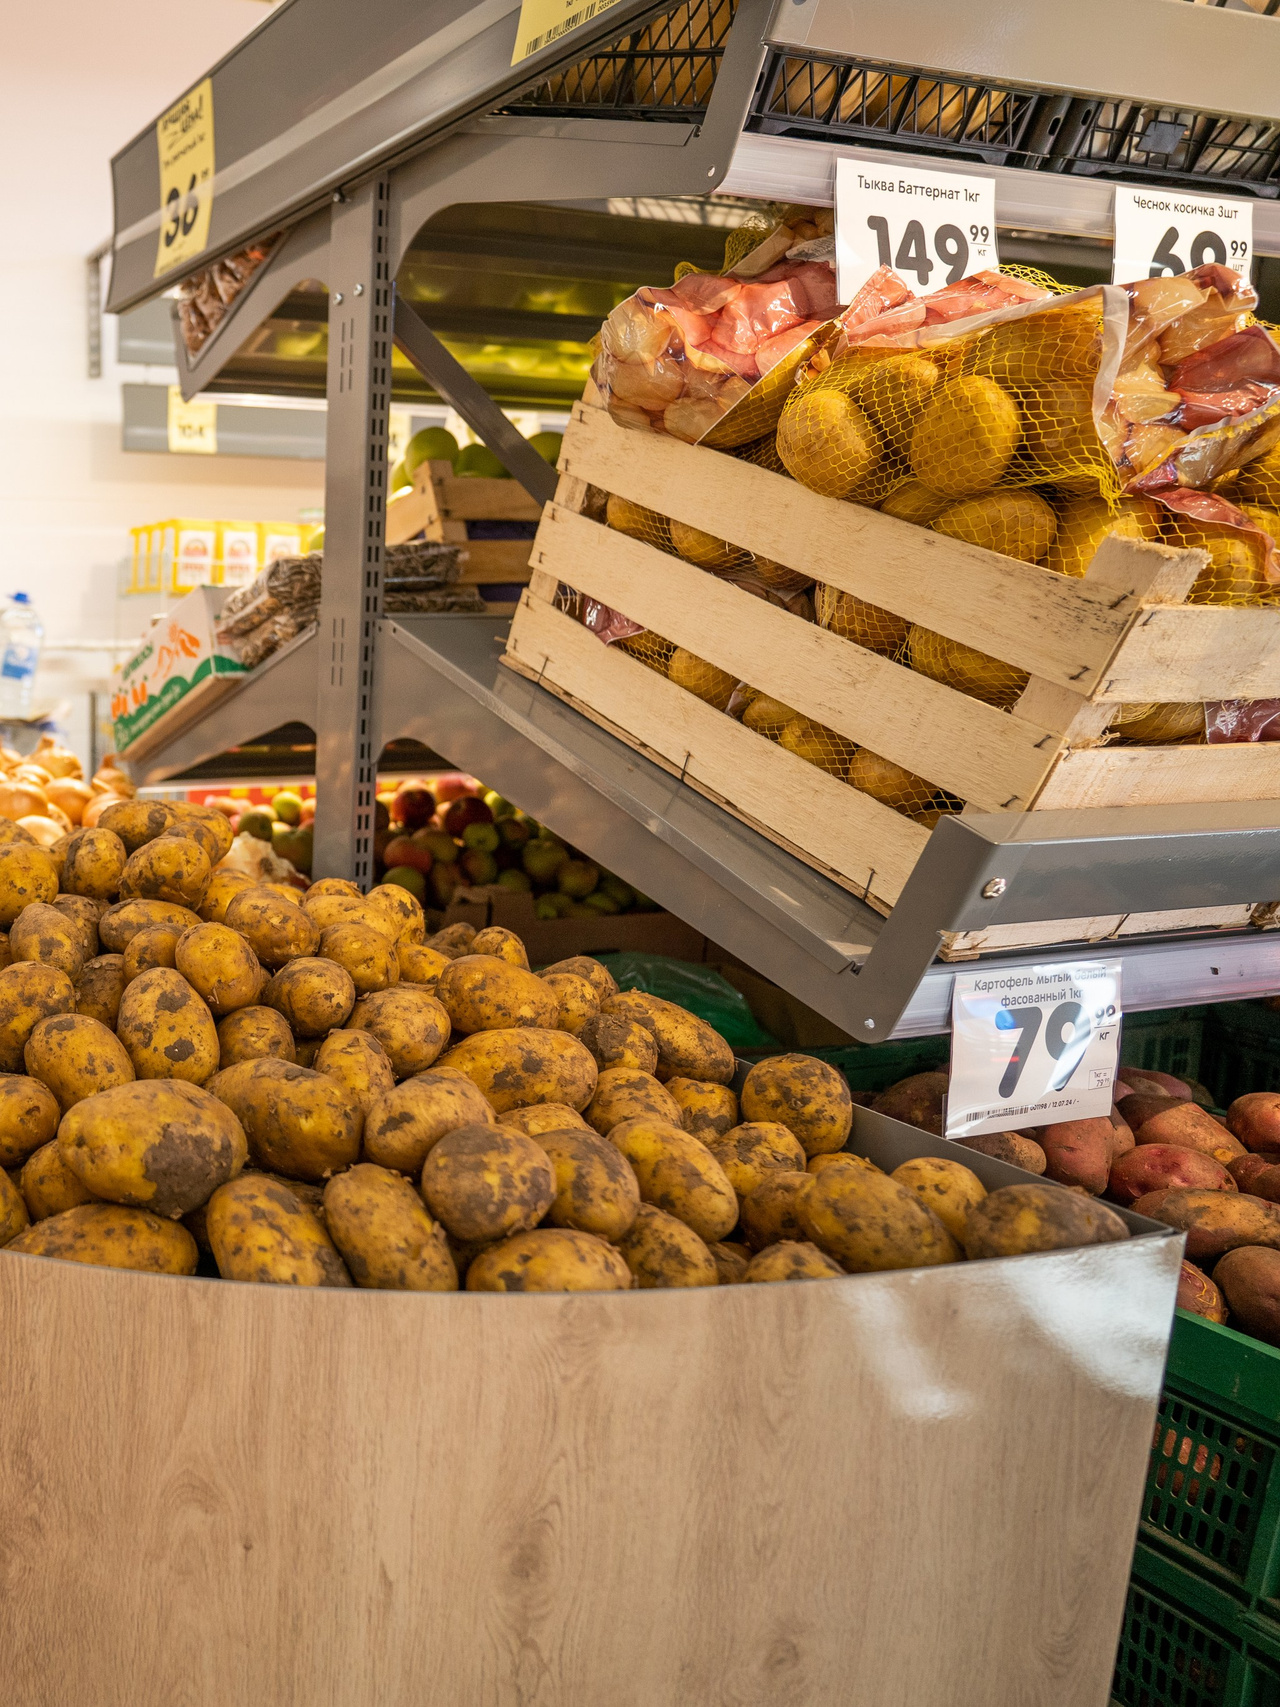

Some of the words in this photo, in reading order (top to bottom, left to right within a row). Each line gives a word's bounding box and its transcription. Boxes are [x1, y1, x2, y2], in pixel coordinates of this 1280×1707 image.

[857, 174, 895, 192] Тыква
[898, 180, 960, 201] Баттернат
[964, 188, 980, 203] 1кг
[1133, 195, 1171, 211] Чеснок
[1174, 202, 1215, 217] косичка
[1217, 205, 1239, 219] 3шт
[867, 215, 969, 286] 149
[970, 224, 990, 243] 99
[977, 248, 987, 256] кг
[1230, 240, 1248, 257] 99
[1232, 263, 1244, 272] шт
[974, 976, 1034, 993] Картофель
[1074, 966, 1107, 980] белый
[1001, 988, 1067, 1008] фасованный
[1069, 988, 1083, 999] 1кг
[1099, 1031, 1110, 1041] кг
[995, 1001, 1092, 1098] 79
